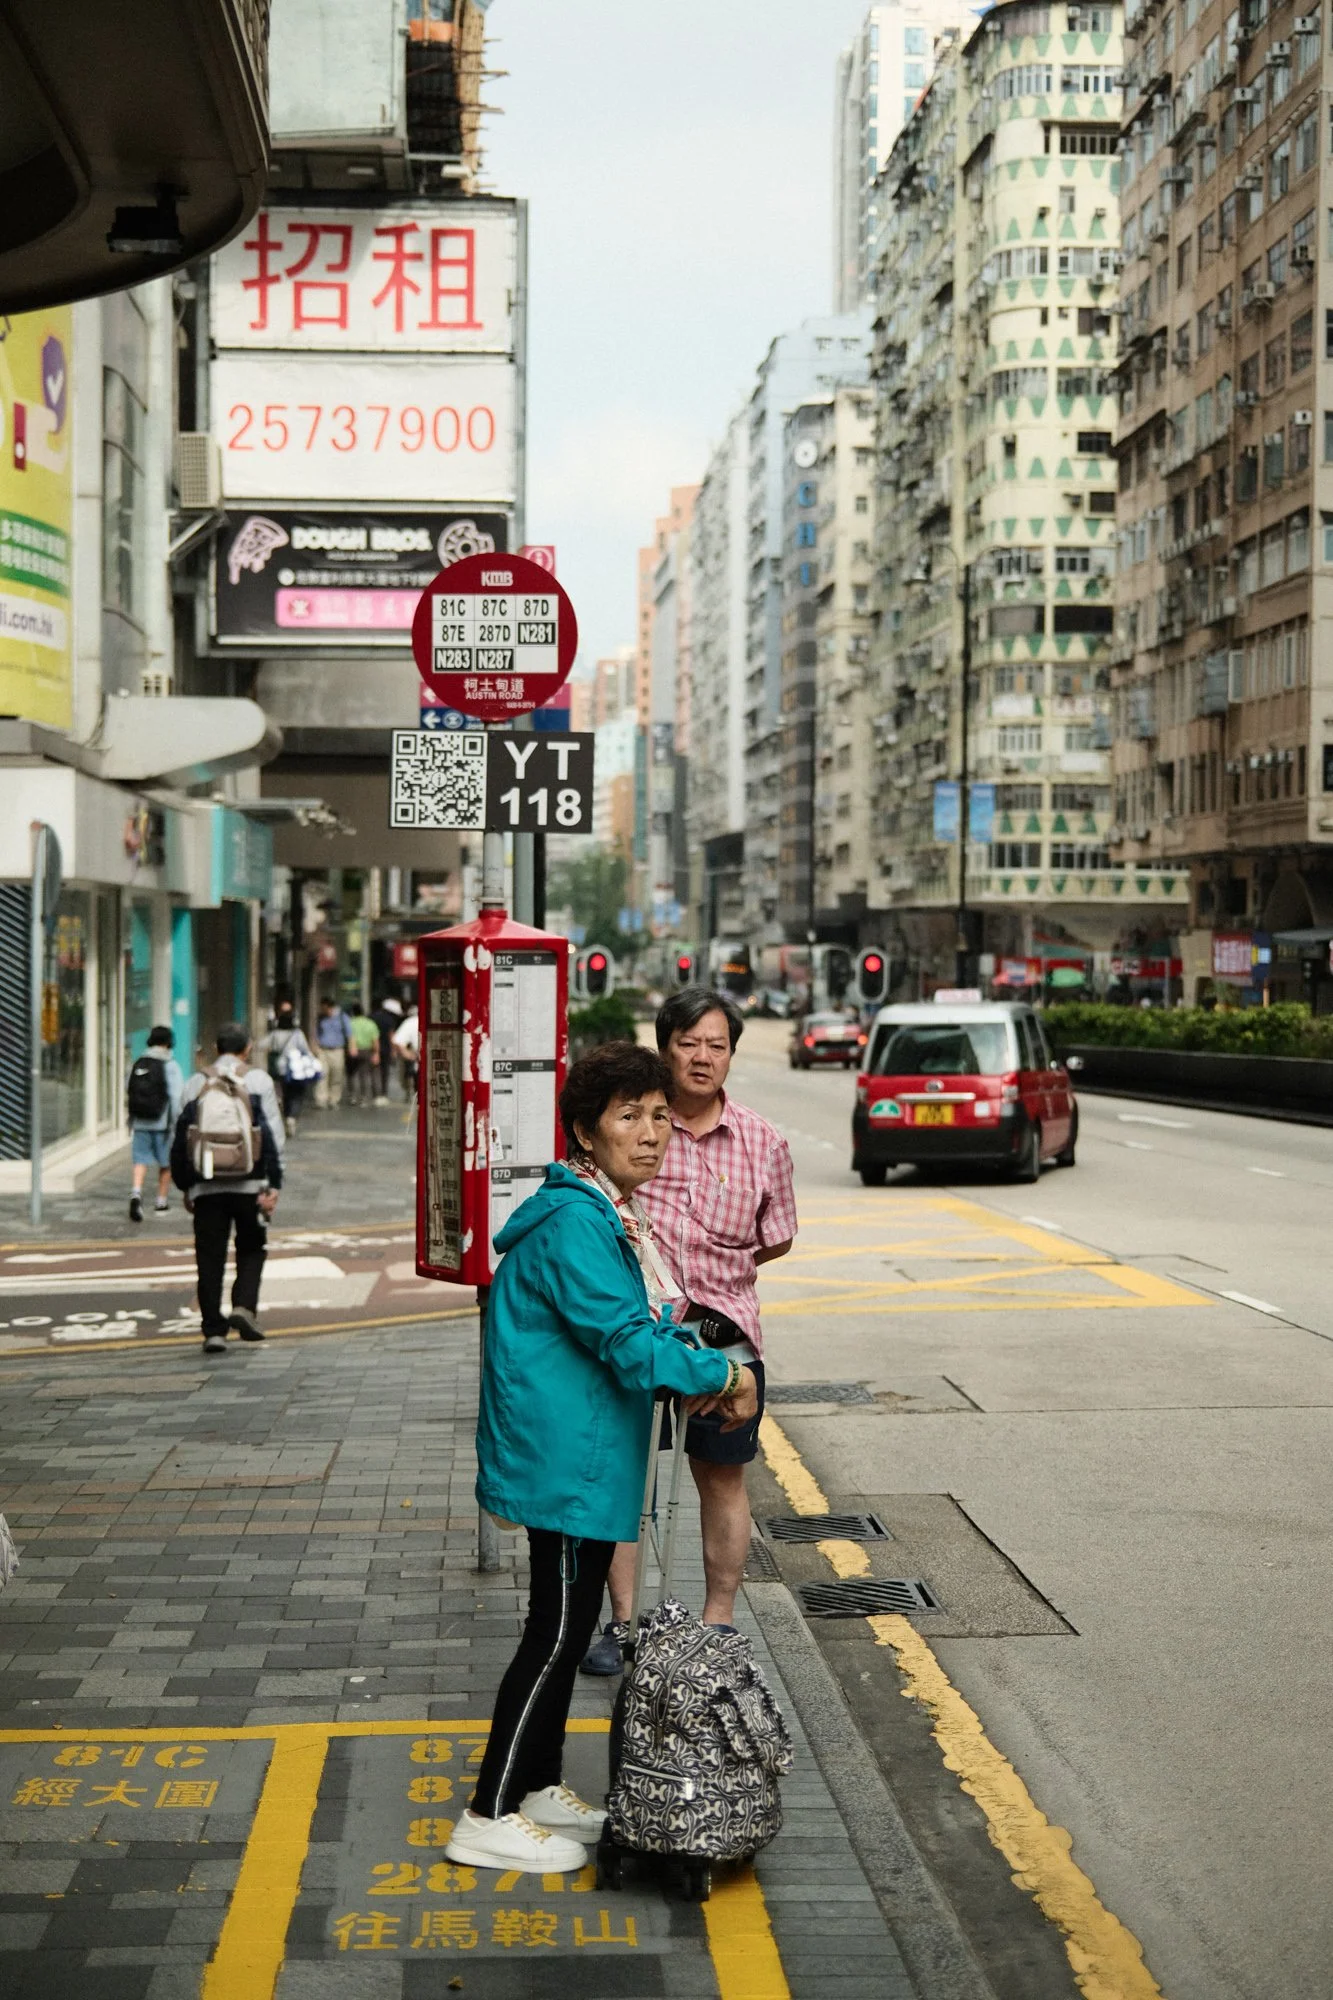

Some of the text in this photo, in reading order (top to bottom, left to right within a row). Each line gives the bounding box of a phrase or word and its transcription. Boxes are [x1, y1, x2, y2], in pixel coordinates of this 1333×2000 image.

[241, 212, 484, 333] 招租
[227, 403, 496, 453] 25737900
[291, 526, 368, 550] DOUGH
[481, 570, 514, 587] KMB
[440, 599, 549, 617] 81C 87C 87D
[442, 624, 552, 644] 87E 287D N281
[436, 650, 512, 669] N283 N287
[464, 678, 525, 693] 柯士甸道
[465, 691, 524, 700] AUSTIN ROAD
[500, 786, 582, 827] 118
[495, 955, 513, 966] 81C
[494, 1061, 513, 1072] 87C
[492, 1168, 511, 1179] 87D
[0, 1309, 157, 1329] OOK
[53, 1745, 208, 1769] 81C
[409, 1738, 489, 1763] 87
[11, 1776, 219, 1809] 經大圍
[331, 1908, 638, 1951] 往馬鞍山
